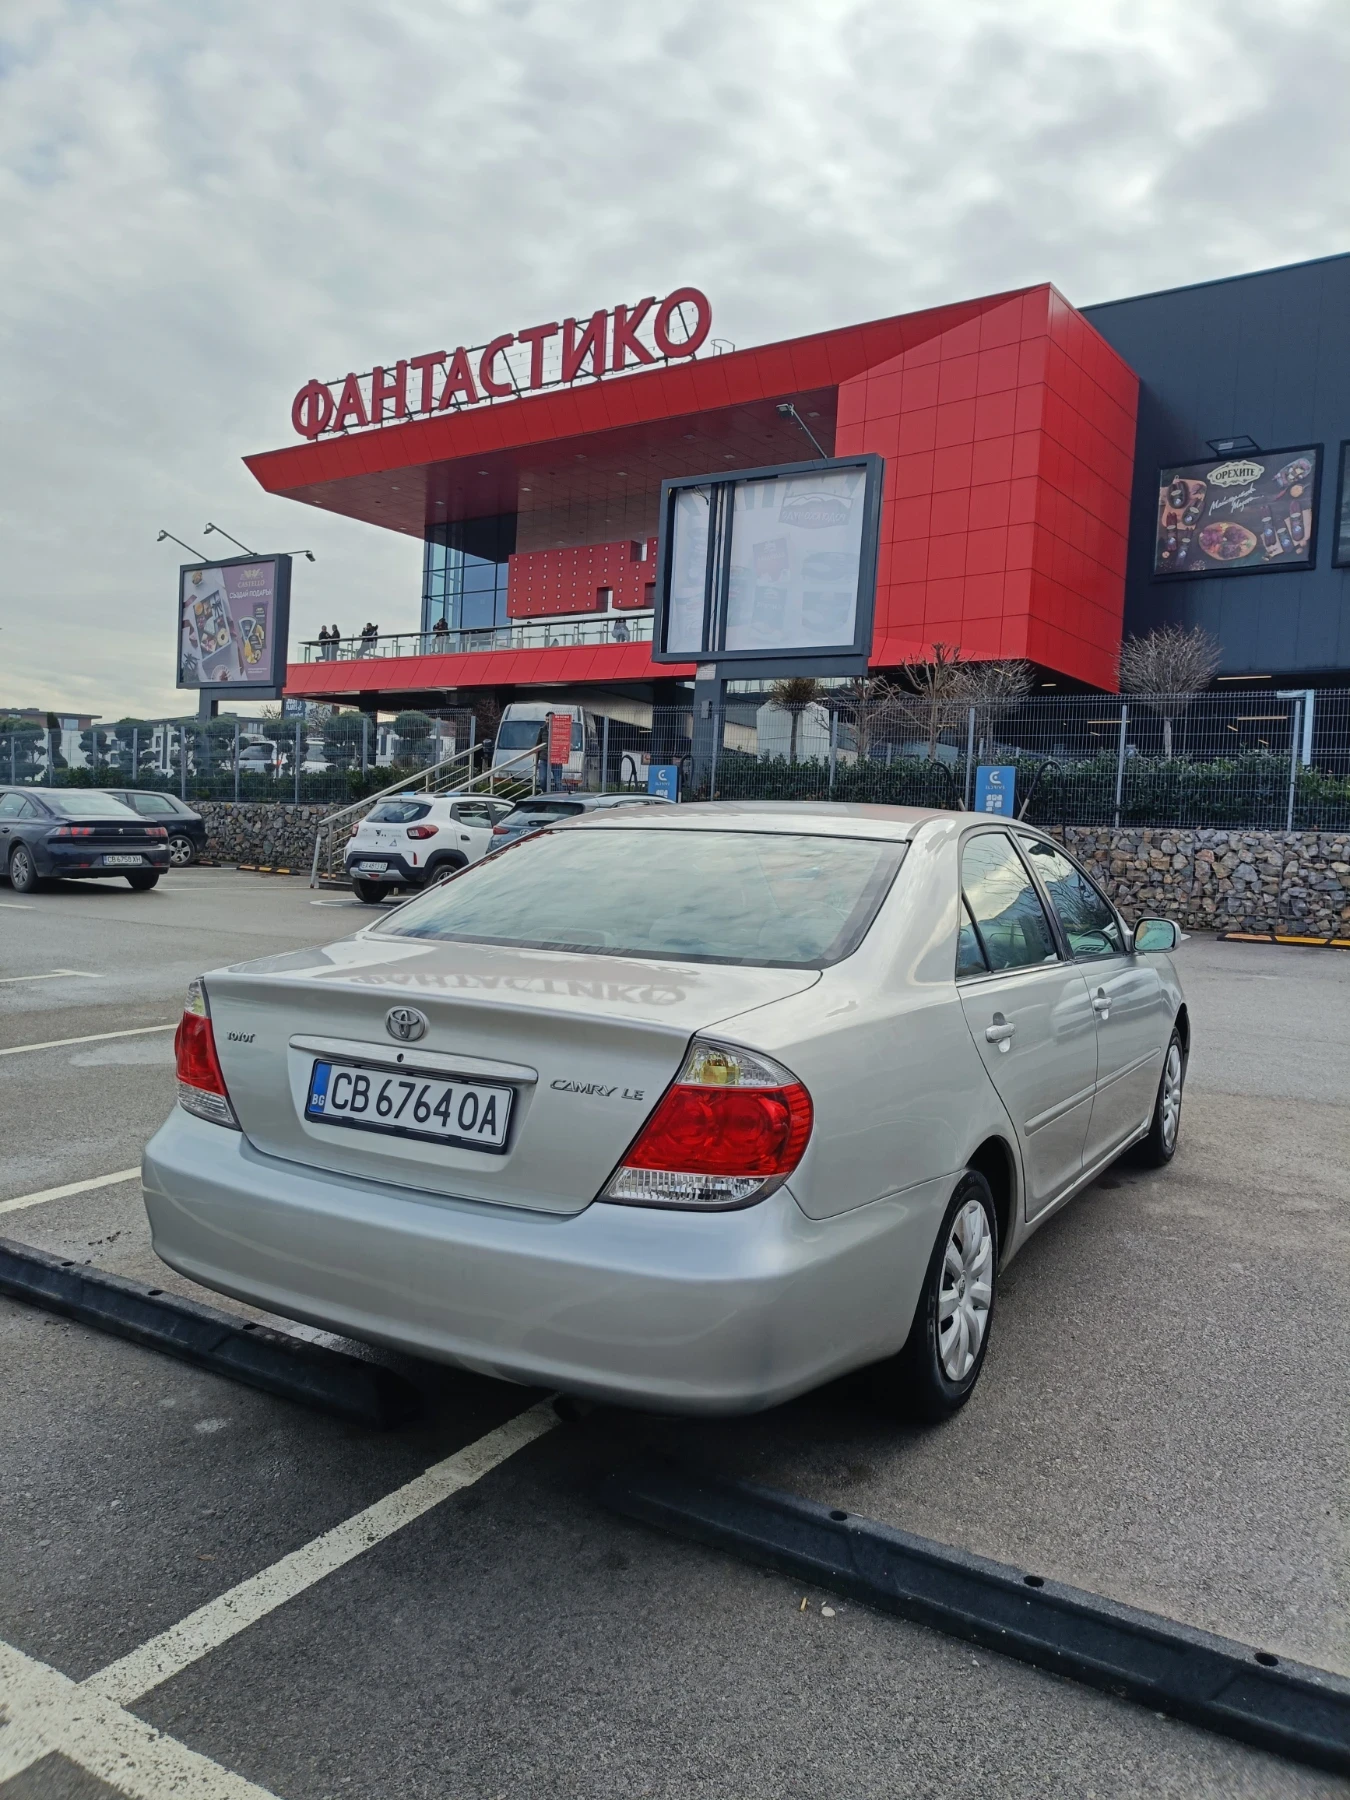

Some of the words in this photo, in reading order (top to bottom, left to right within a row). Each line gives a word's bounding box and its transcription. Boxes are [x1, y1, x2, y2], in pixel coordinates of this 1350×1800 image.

[291, 287, 712, 440] ФАНТАСТИКО
[1215, 468, 1256, 480] ОРЕХИТЕ
[237, 580, 265, 588] CASTELLO
[249, 588, 273, 598] ПОДАРЪК
[550, 1079, 618, 1097] CAMRY
[621, 1088, 645, 1101] LE
[311, 1094, 326, 1107] BG
